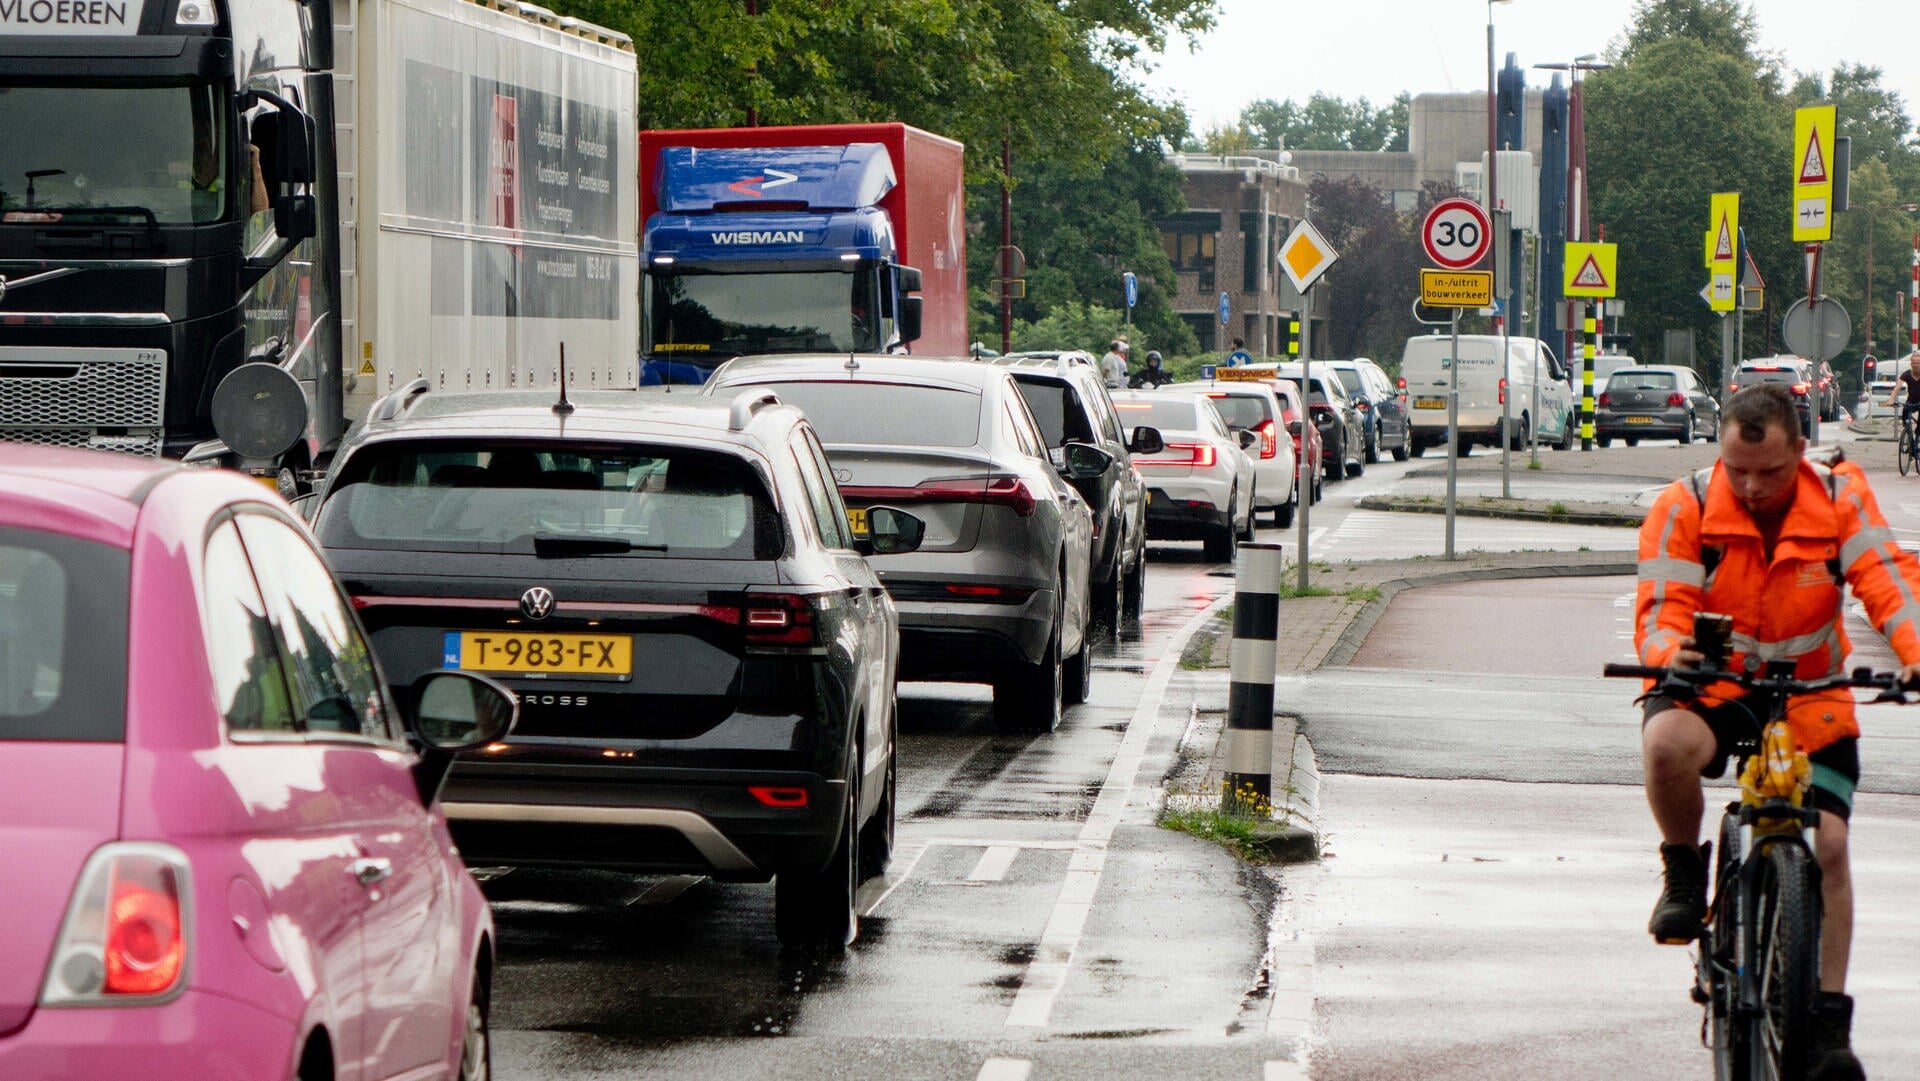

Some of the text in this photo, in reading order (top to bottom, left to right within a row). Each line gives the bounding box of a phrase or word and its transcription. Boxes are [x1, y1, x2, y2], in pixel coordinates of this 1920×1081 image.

[0, 0, 126, 25] VLOEREN
[711, 231, 804, 245] WISMAN
[1436, 221, 1479, 247] 30
[1434, 277, 1479, 288] in-/uitrit
[1426, 289, 1488, 299] bouwverkeer
[1217, 369, 1275, 378] VERONICA
[445, 638, 615, 668] NL T-983-FX
